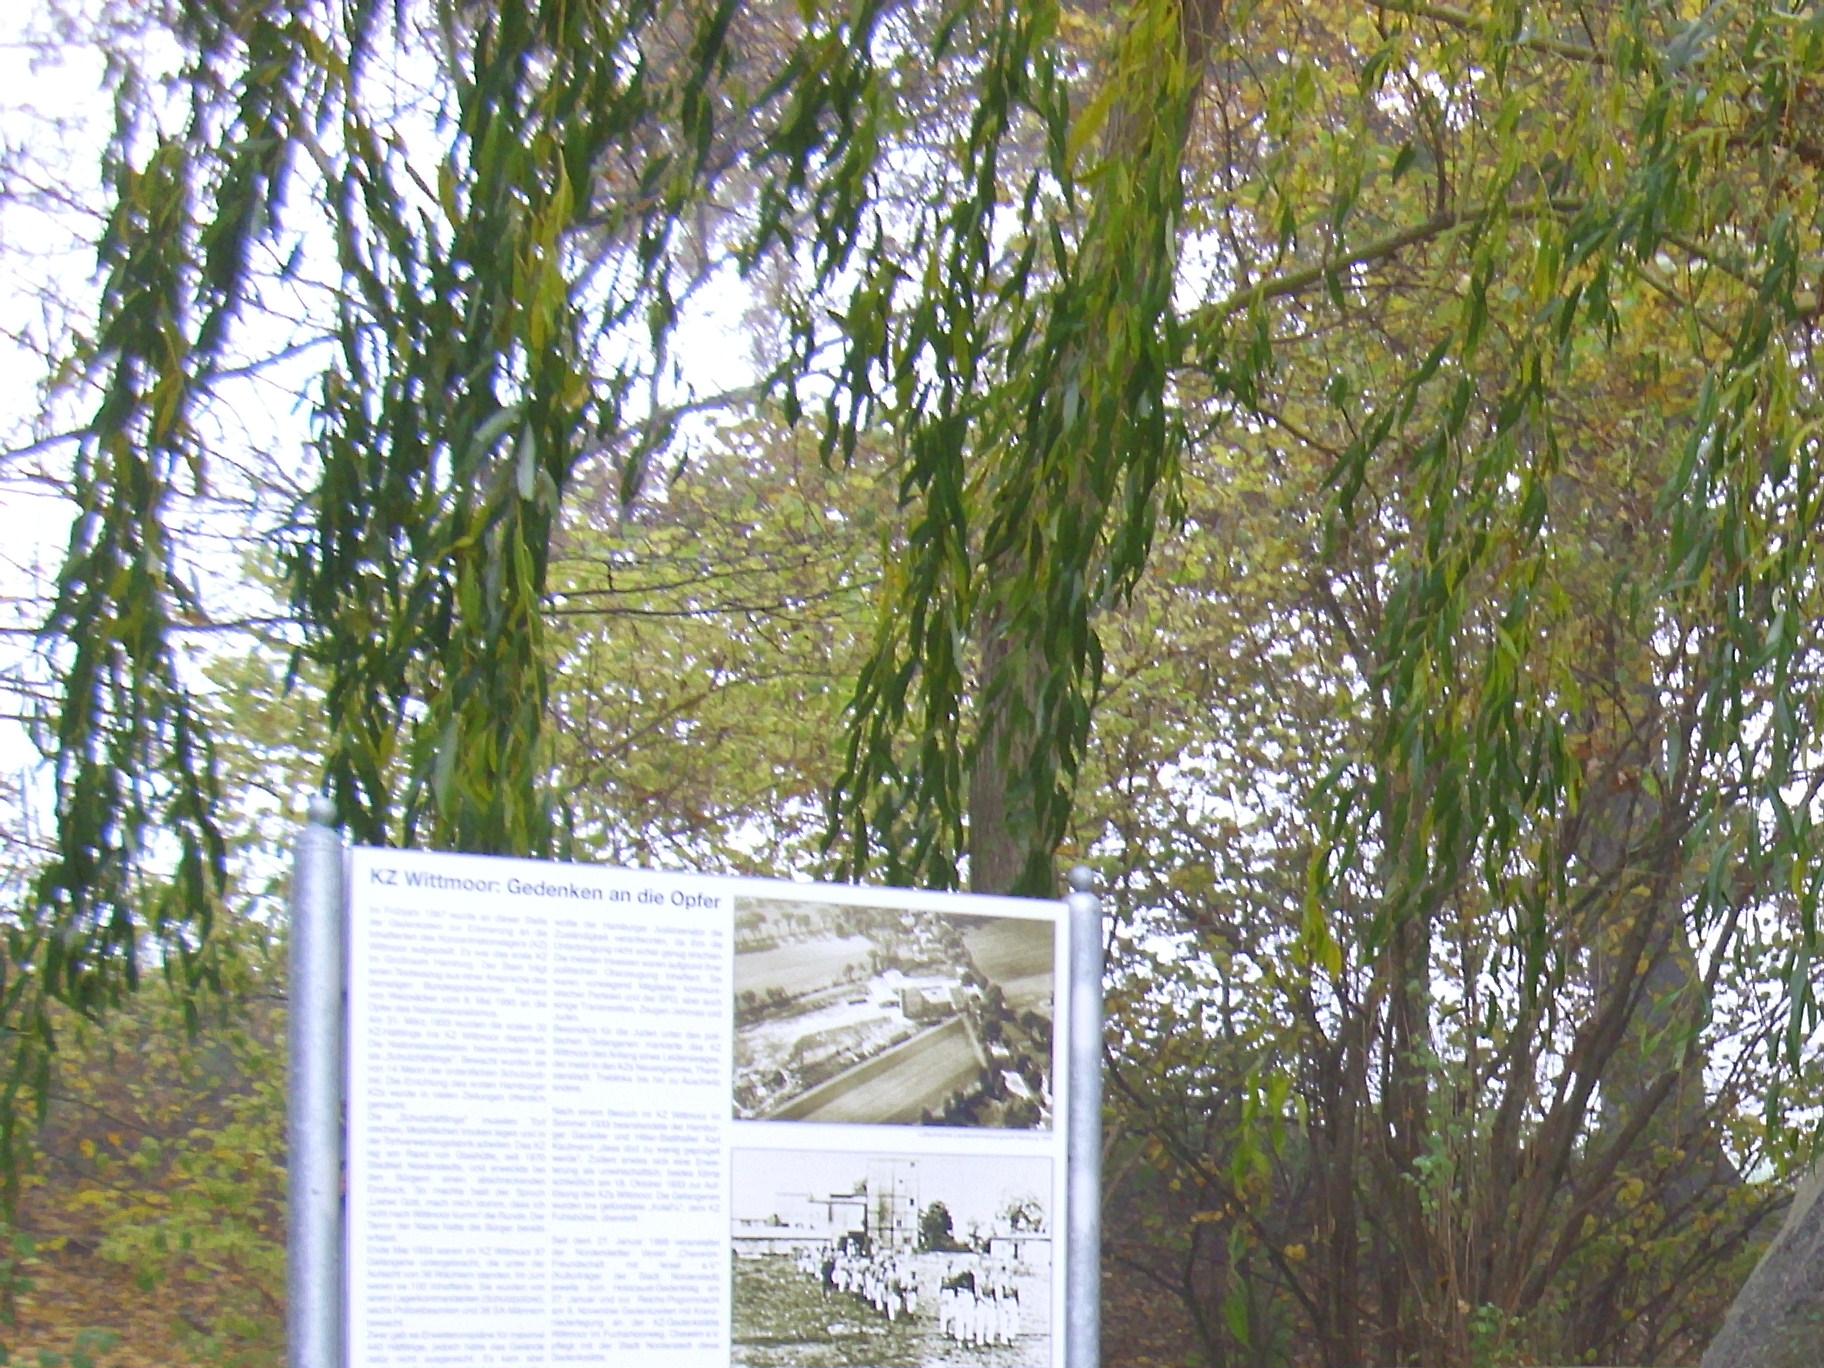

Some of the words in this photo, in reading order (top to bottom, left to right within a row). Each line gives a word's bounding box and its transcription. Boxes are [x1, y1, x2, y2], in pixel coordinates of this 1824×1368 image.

[370, 868, 398, 886] KZ
[404, 871, 501, 893] Wittmoor:
[507, 878, 603, 901] Gedenken
[609, 889, 631, 902] an
[637, 888, 665, 904] die
[671, 890, 722, 910] Opfer
